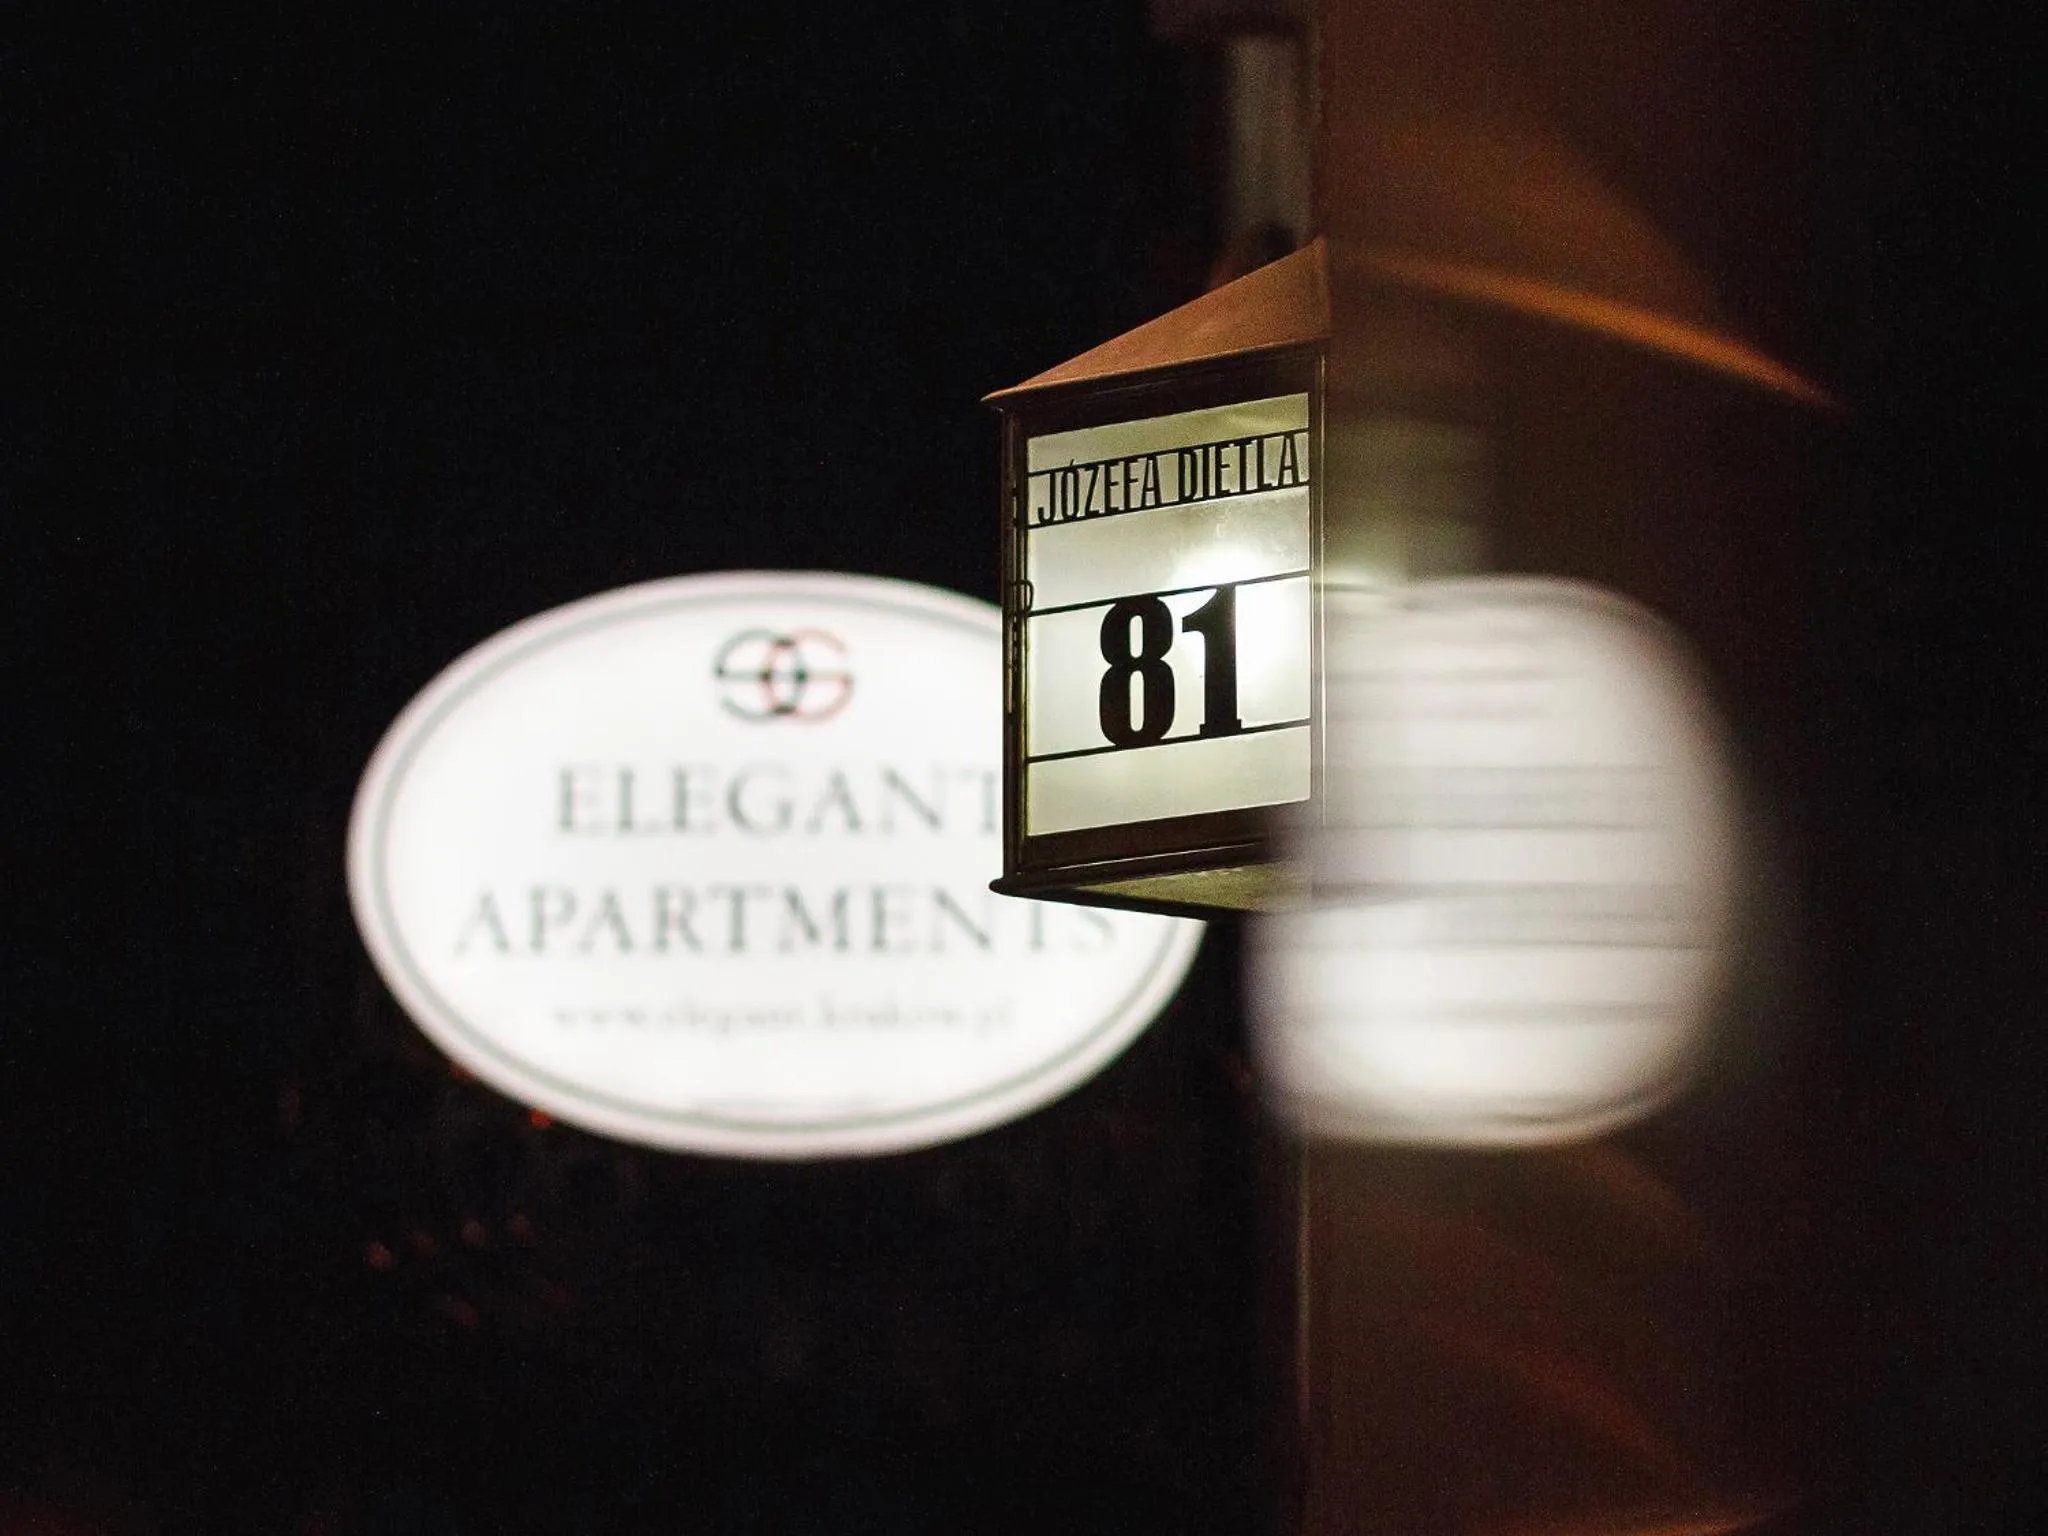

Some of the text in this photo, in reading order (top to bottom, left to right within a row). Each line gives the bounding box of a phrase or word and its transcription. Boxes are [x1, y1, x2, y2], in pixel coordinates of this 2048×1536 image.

[1038, 431, 1302, 527] JÓZEFA DIETLA
[1100, 582, 1242, 747] 81
[554, 764, 1003, 836] ELEGANT
[454, 884, 1119, 957] APARTMENTS
